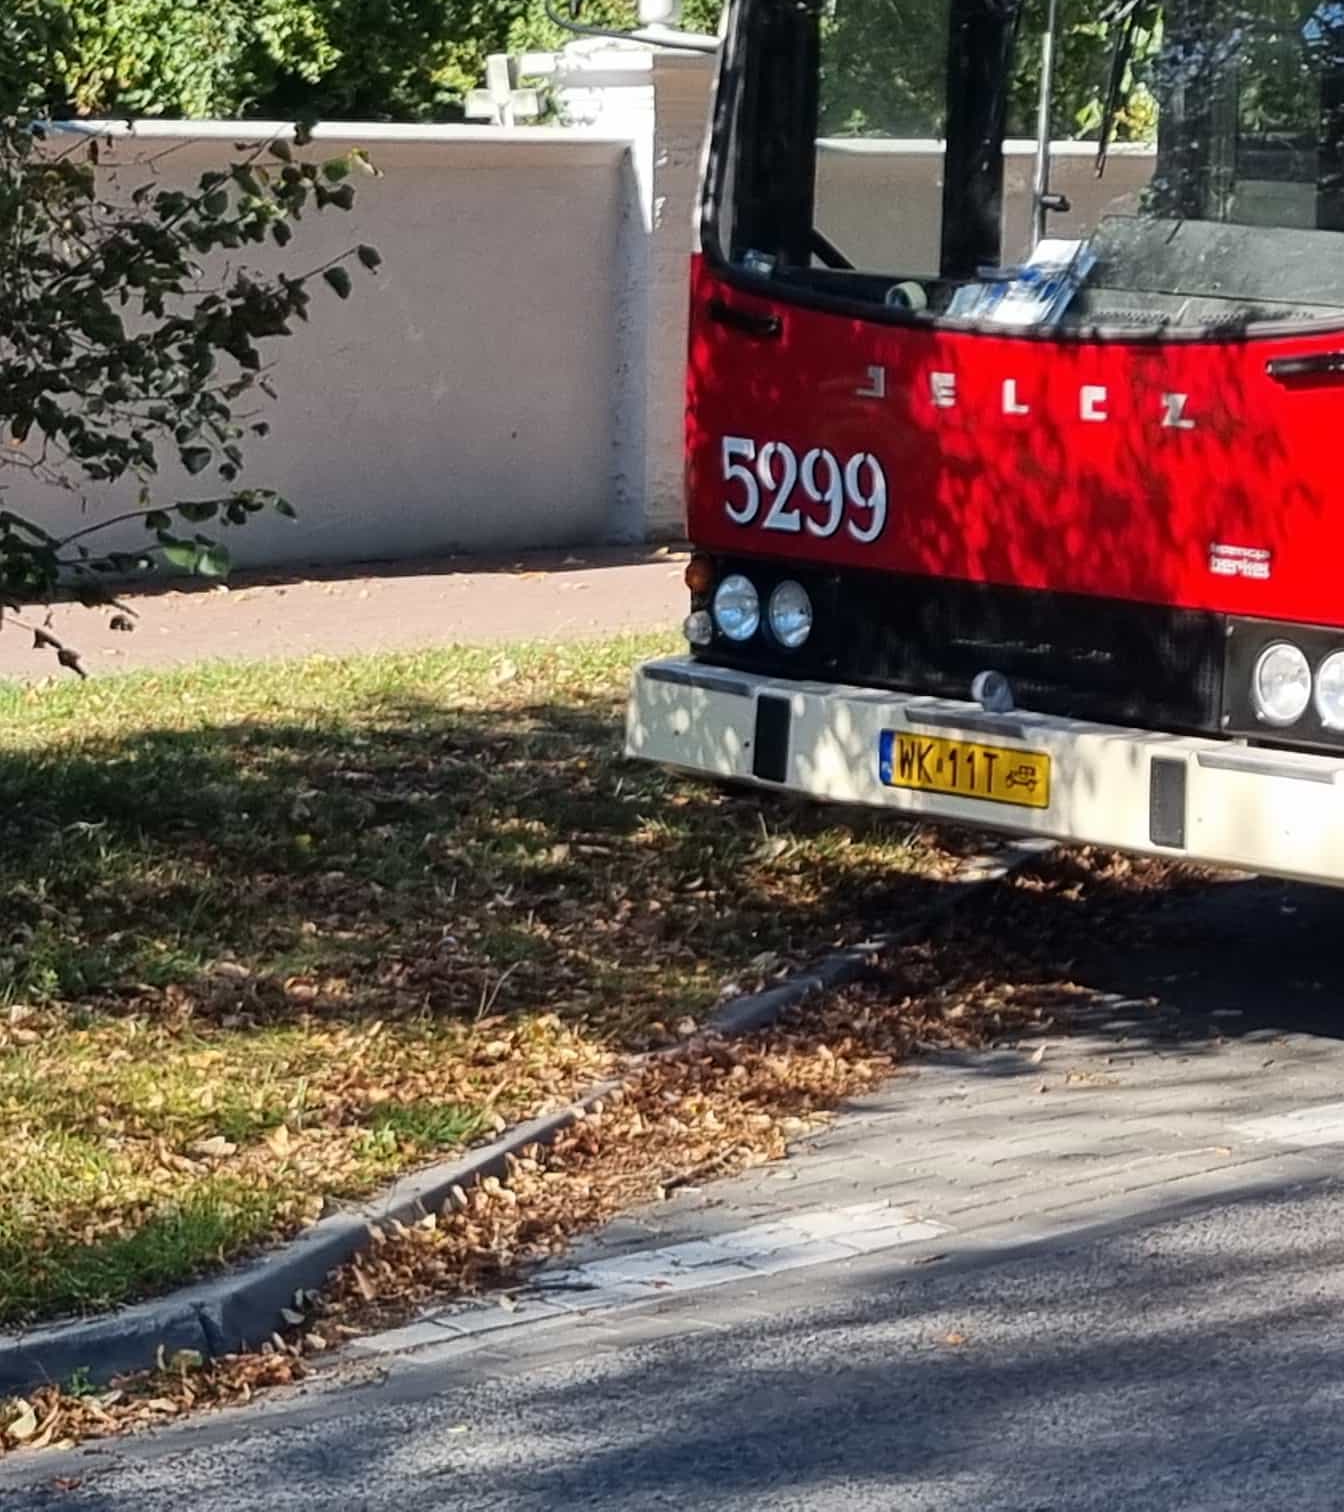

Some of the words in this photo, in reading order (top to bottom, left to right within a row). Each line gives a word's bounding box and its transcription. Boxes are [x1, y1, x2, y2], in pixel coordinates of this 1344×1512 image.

[856, 366, 1195, 430] JELCZ
[722, 435, 888, 542] 5299
[899, 738, 933, 784] WK
[948, 748, 999, 793] 11T
